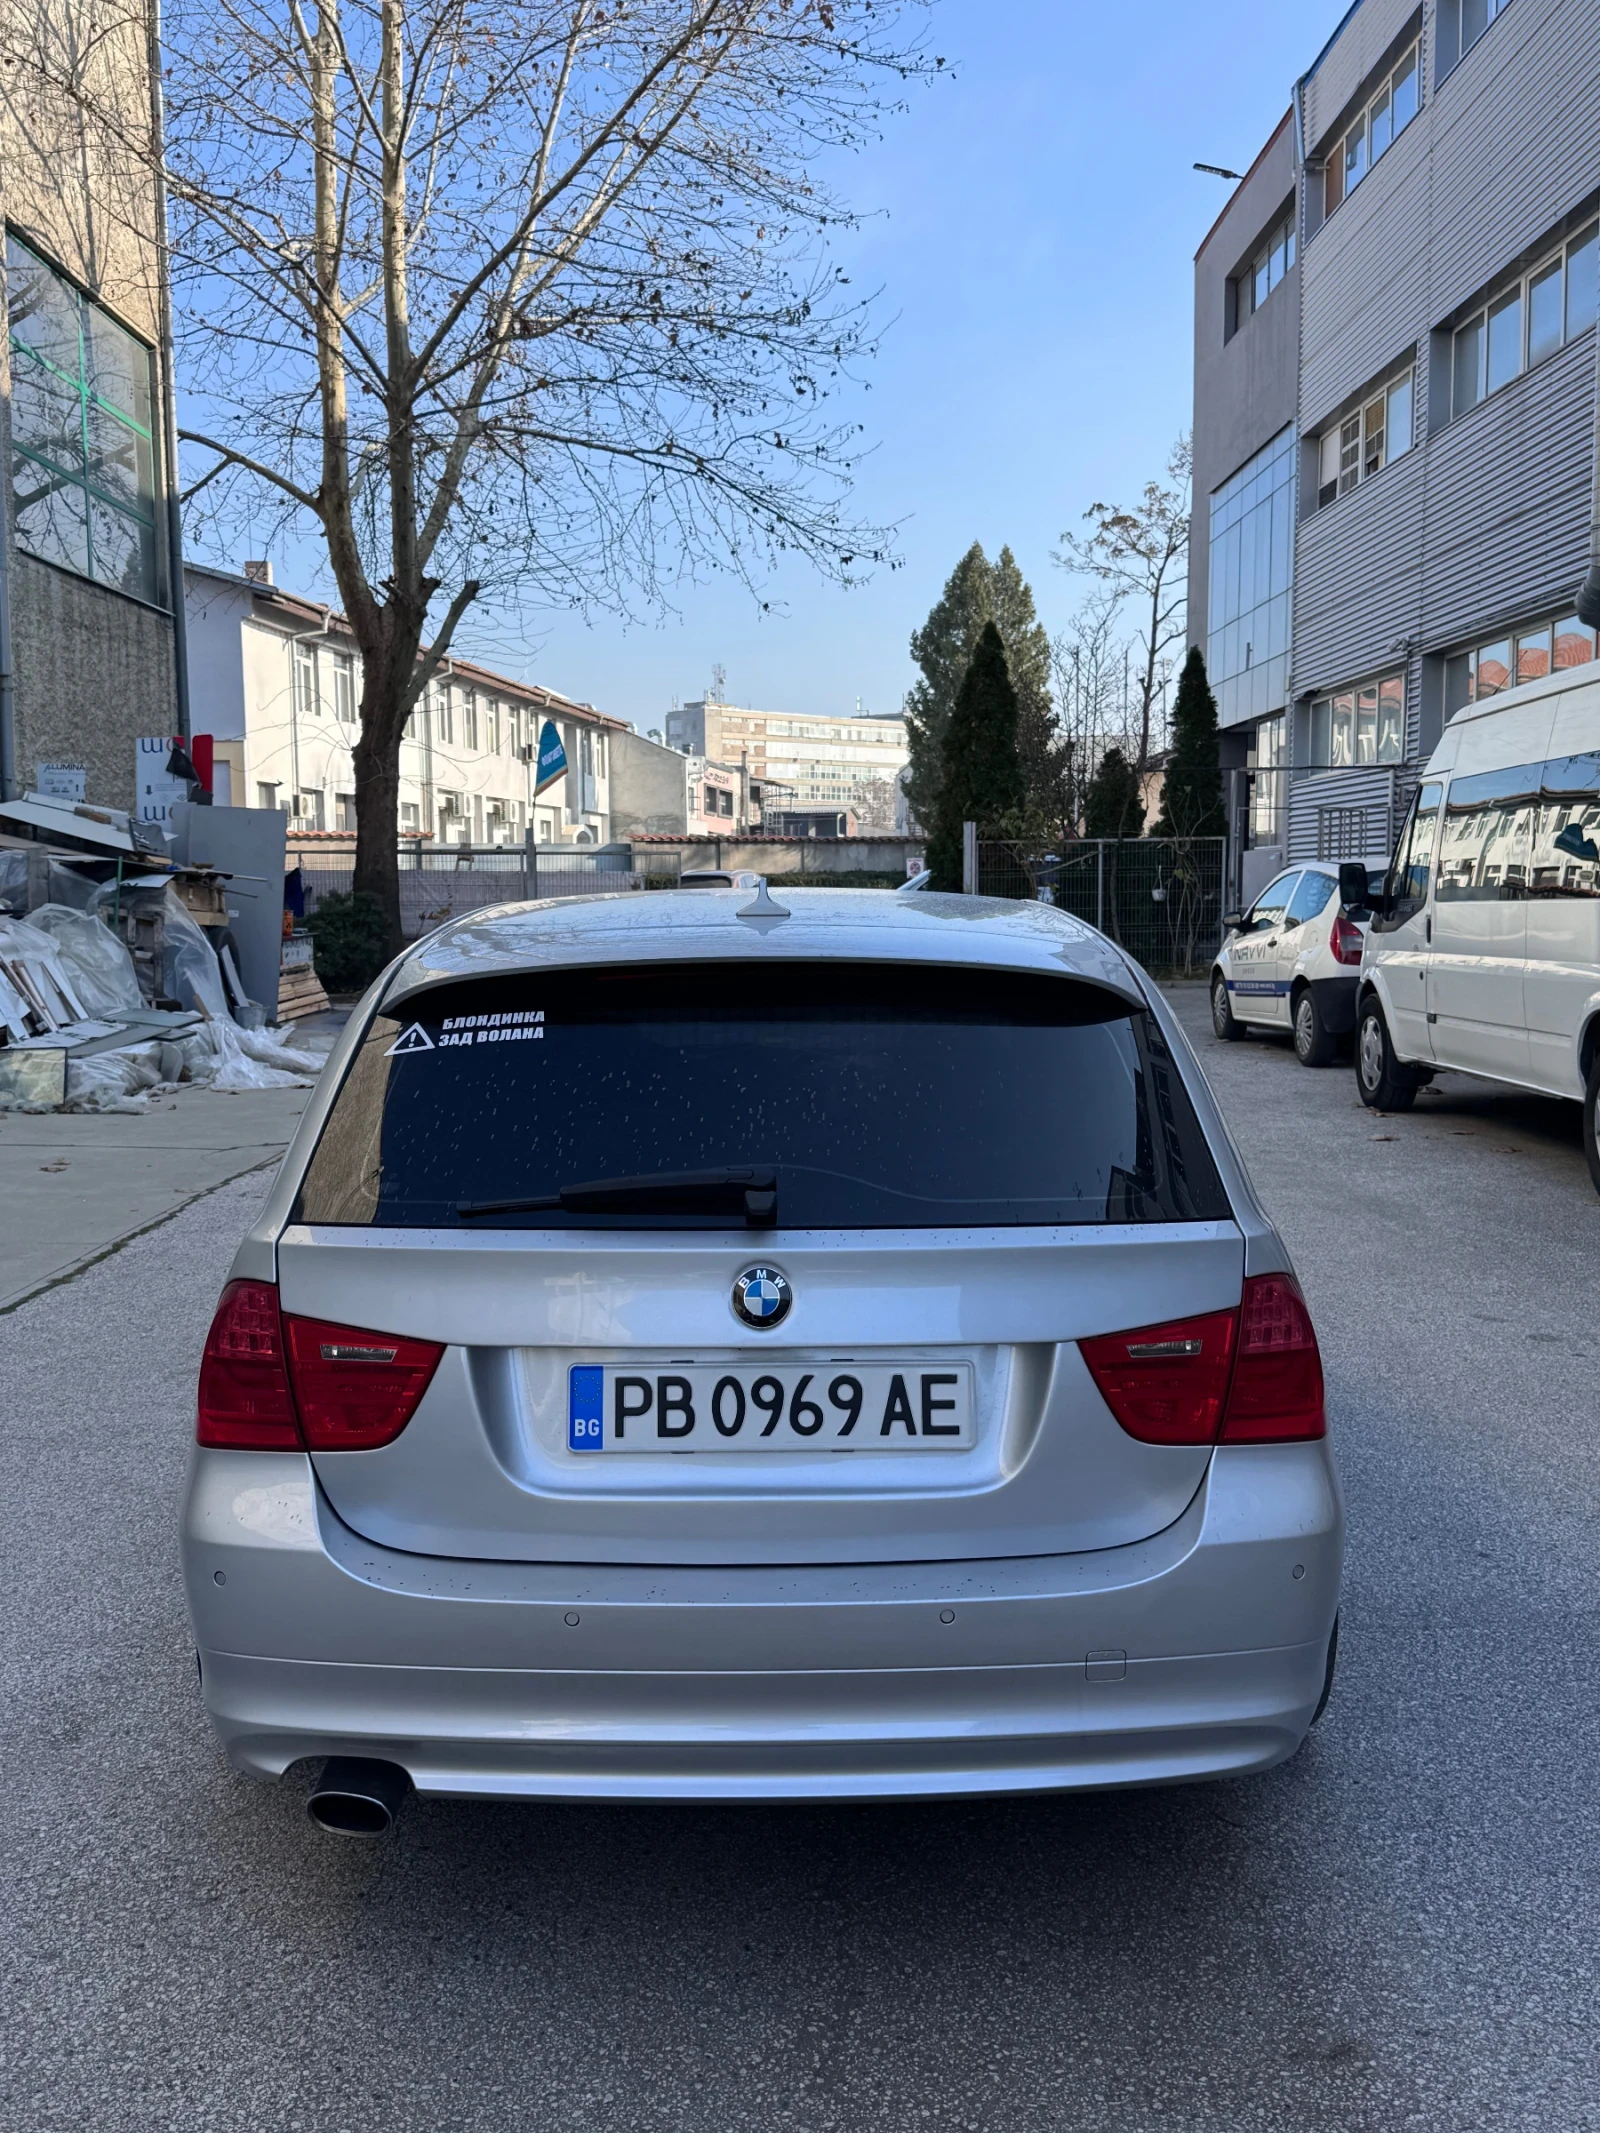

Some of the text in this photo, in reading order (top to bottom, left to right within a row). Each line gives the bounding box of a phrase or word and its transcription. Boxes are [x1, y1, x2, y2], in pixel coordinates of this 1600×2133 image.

[442, 1010, 545, 1030] БЛОНДИНКА
[438, 1026, 544, 1047] ЗАД ВОЛАНА
[738, 1269, 786, 1289] BMW
[615, 1374, 960, 1438] PB 0969 AE
[574, 1418, 600, 1437] BG
